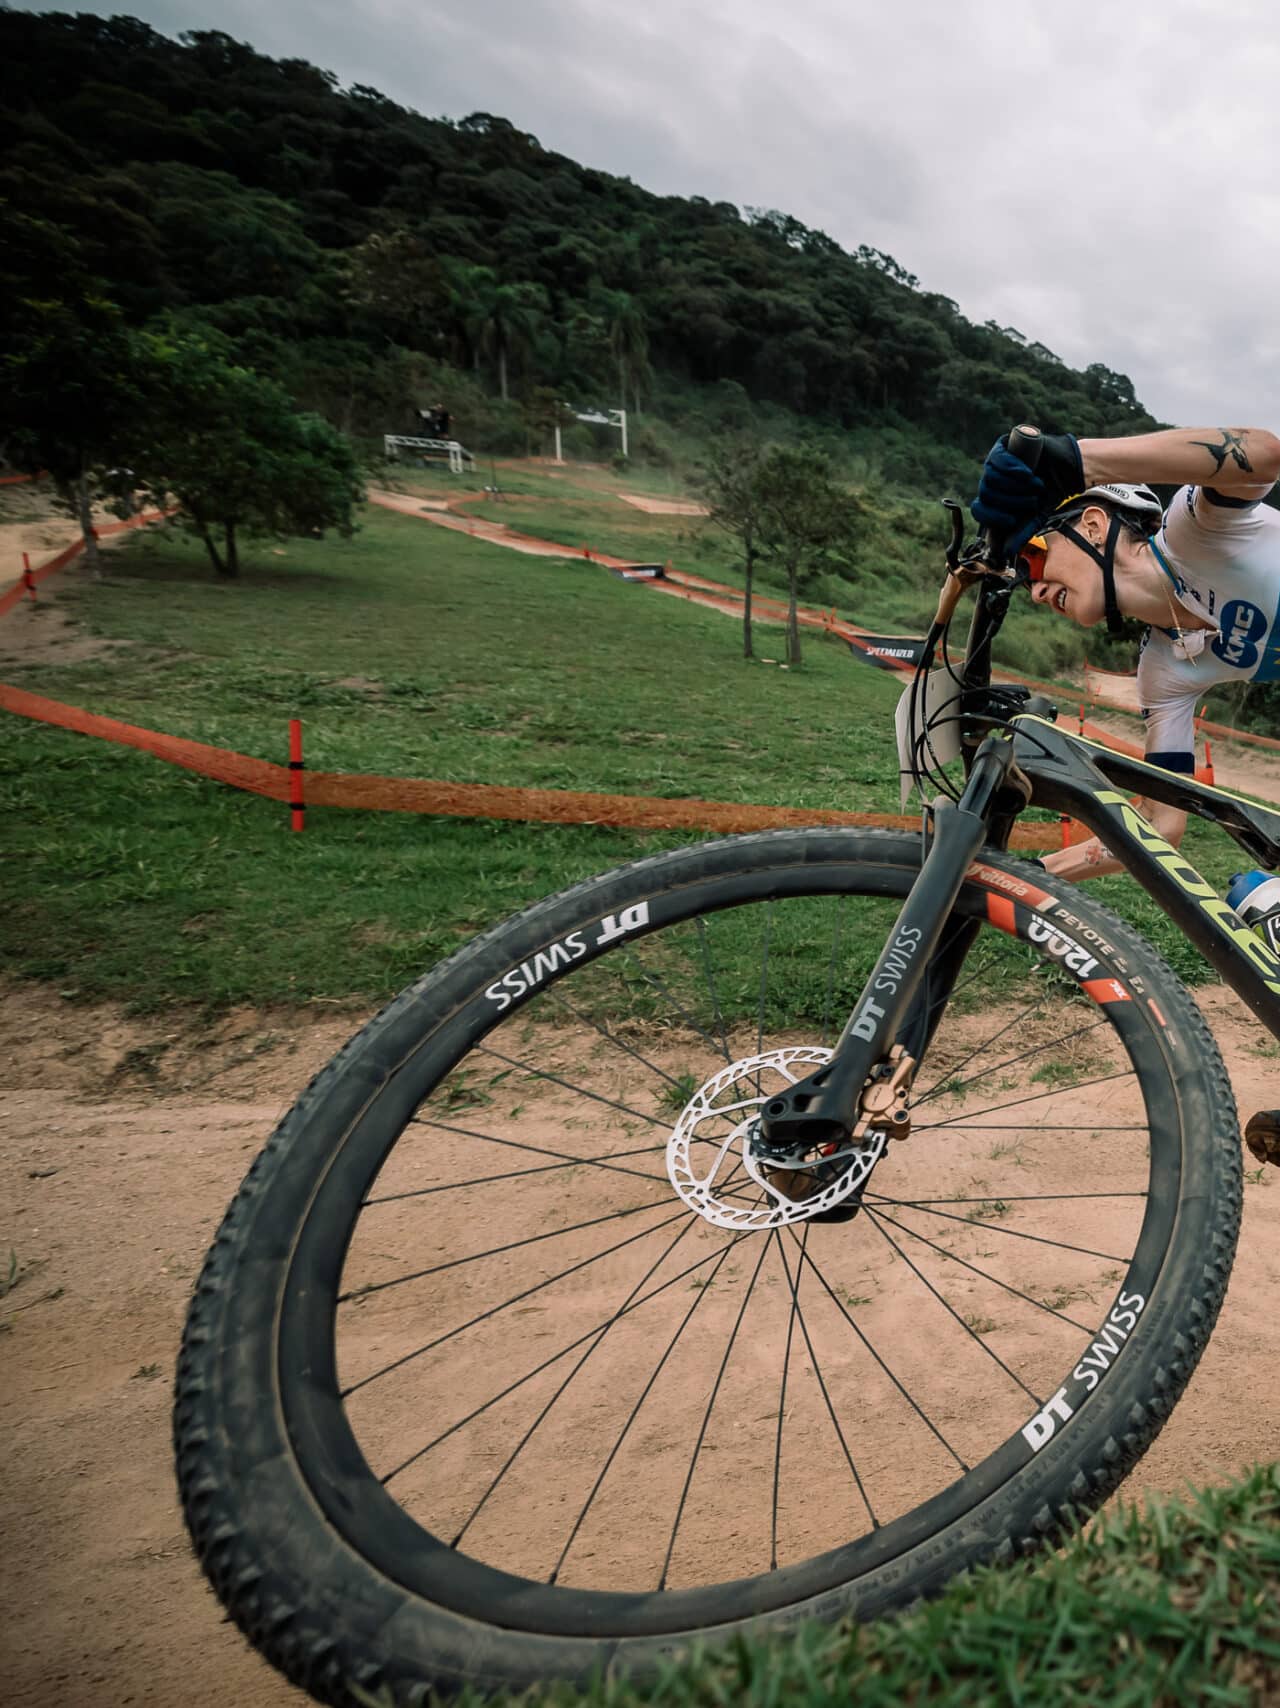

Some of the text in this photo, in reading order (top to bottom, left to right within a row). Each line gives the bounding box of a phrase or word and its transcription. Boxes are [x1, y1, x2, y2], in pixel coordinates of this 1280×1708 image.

[1222, 604, 1256, 664] KMC
[980, 870, 1029, 897] vittoria
[484, 901, 649, 1011] DT SWISS
[1027, 920, 1100, 978] 1200
[1054, 907, 1115, 956] PEYOTE
[850, 925, 922, 1043] DT SWISS
[1021, 1386, 1074, 1452] DT
[1073, 1291, 1145, 1391] SWISS
